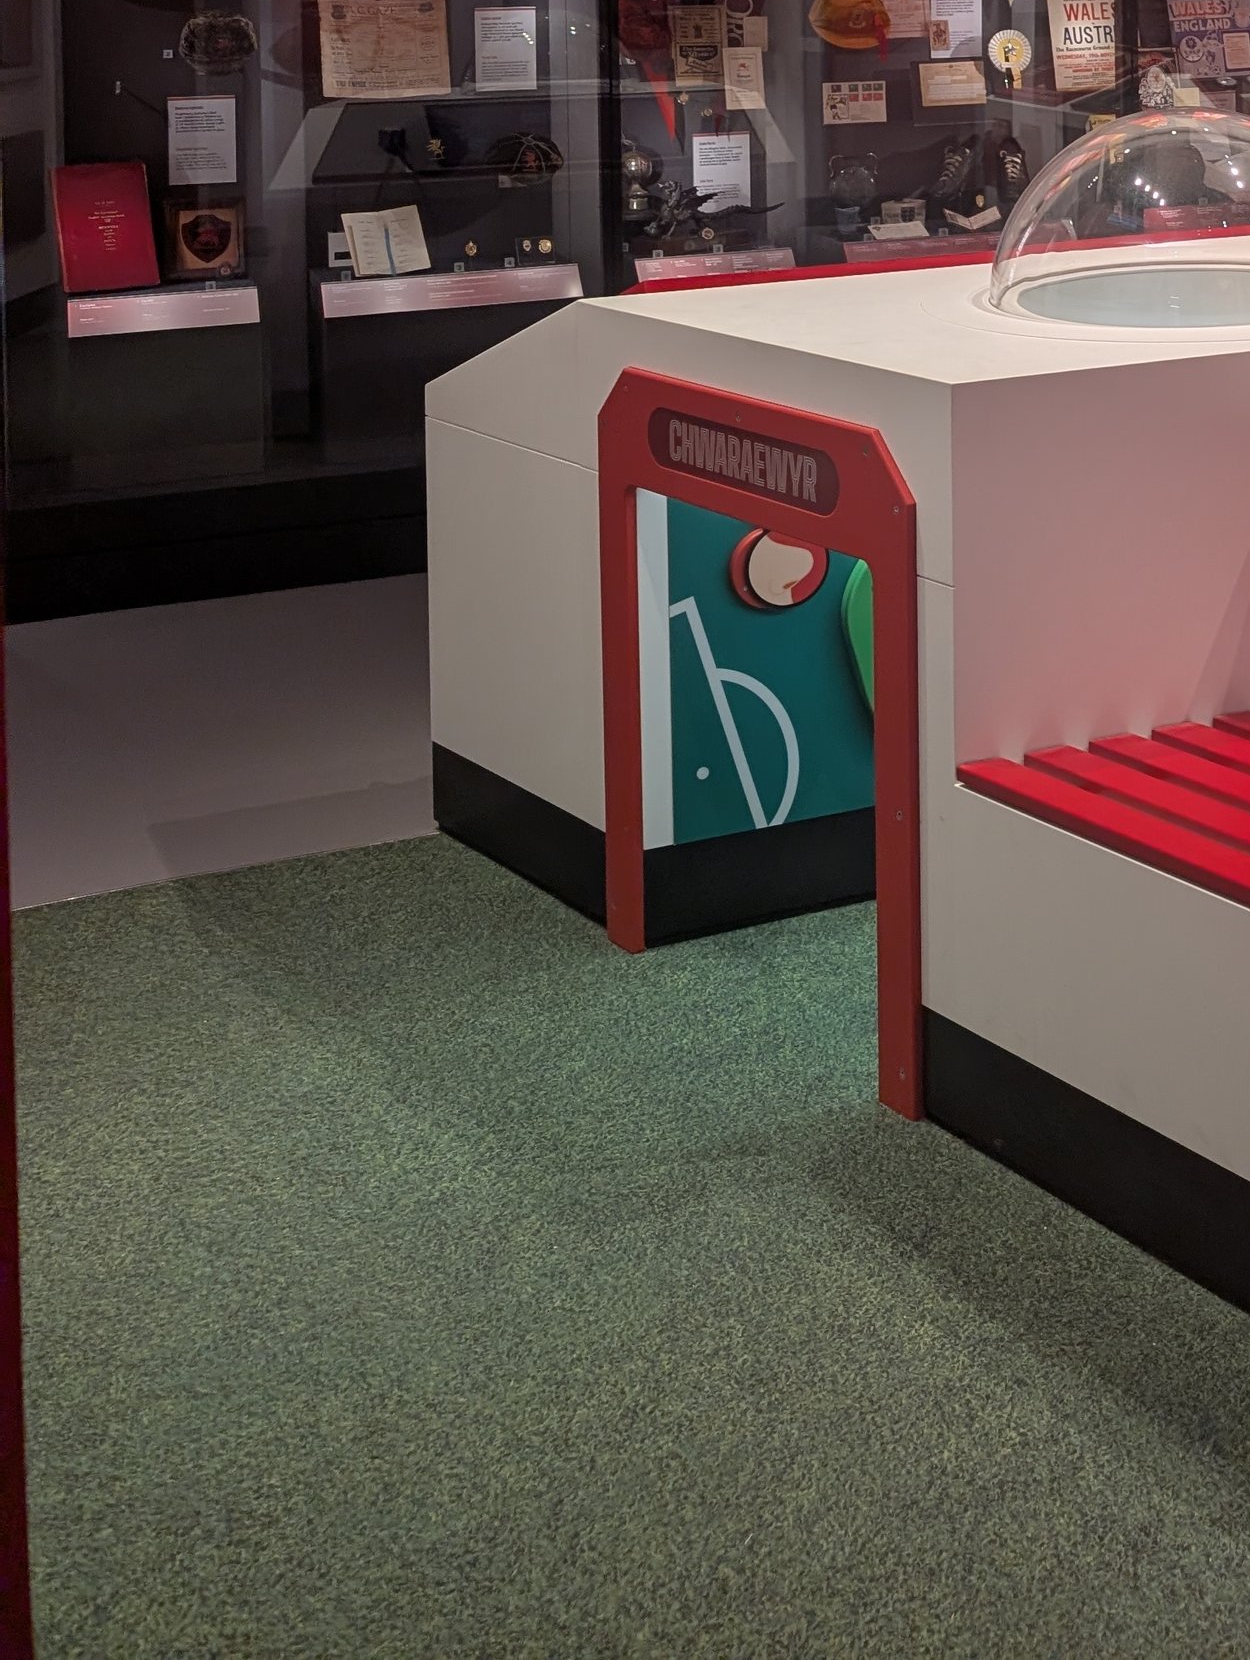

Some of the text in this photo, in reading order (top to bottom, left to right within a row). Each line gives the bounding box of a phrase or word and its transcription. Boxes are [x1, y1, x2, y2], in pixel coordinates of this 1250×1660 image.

[1173, 0, 1227, 17] WALES
[1174, 18, 1231, 32] ENGLAND
[1063, 25, 1114, 45] AUSTR
[668, 418, 818, 504] CHWARAEWYR
